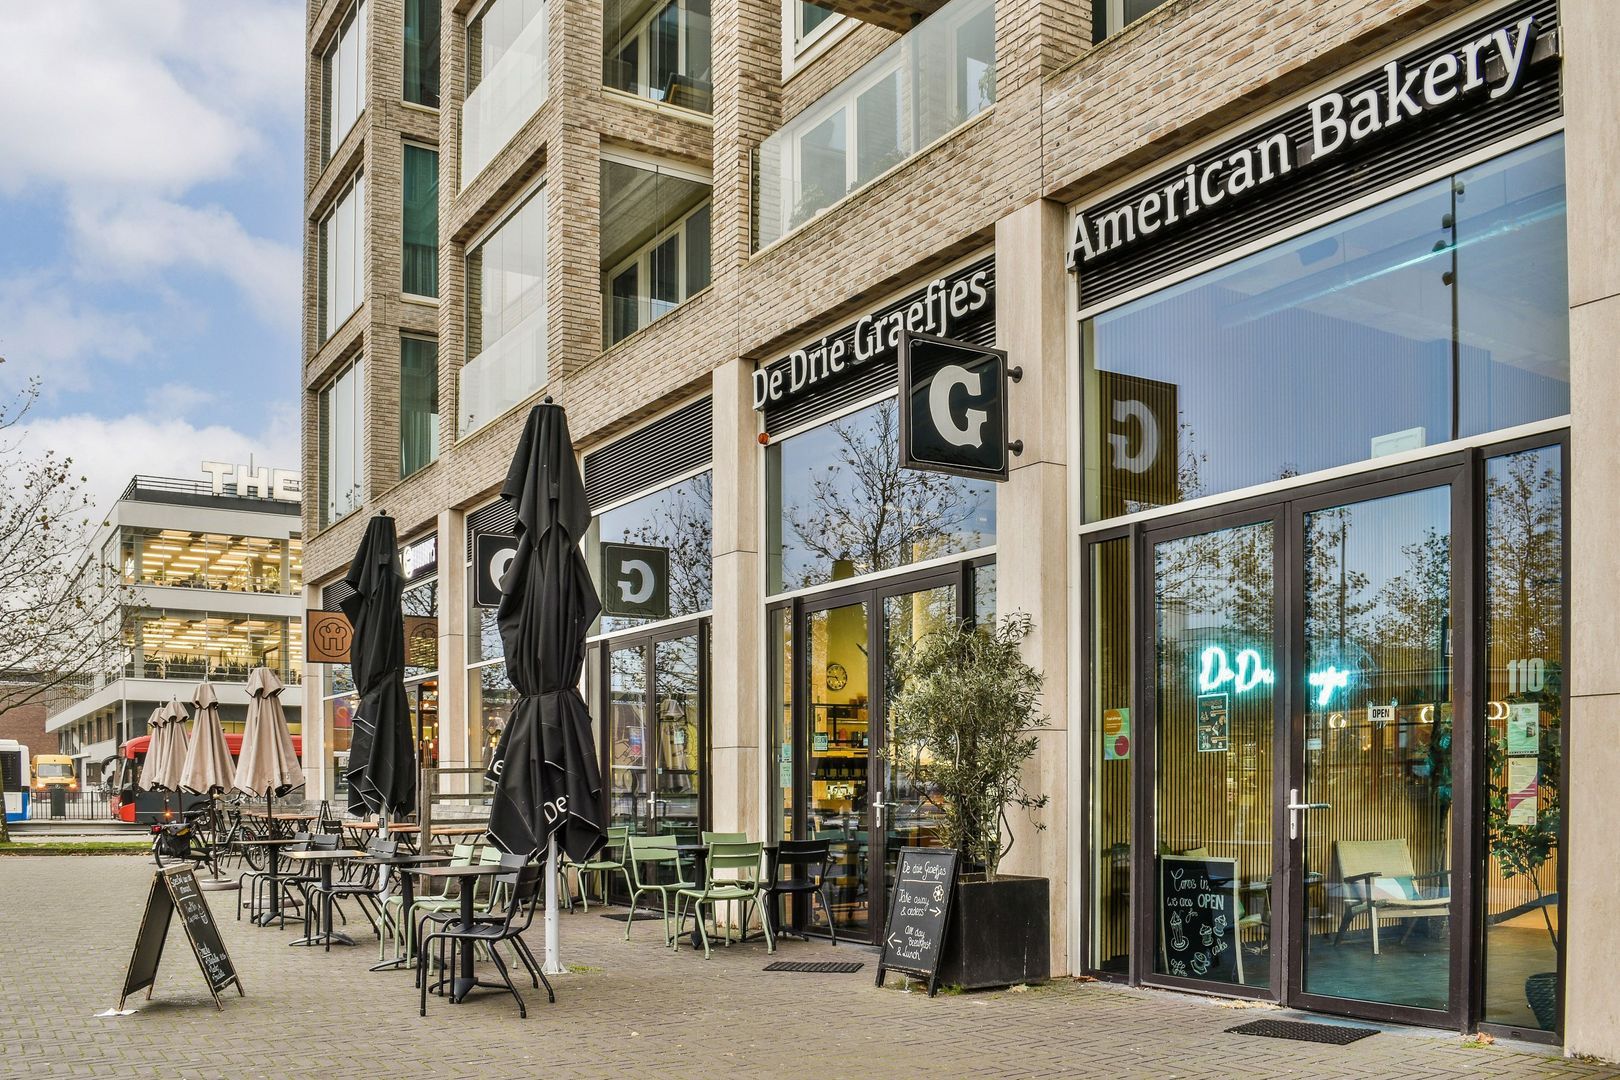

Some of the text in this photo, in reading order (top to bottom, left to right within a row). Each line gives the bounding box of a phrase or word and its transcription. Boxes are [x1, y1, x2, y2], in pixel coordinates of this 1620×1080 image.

[1065, 15, 1538, 270] American Bakery
[752, 271, 987, 411] De Drie Graefjes
[929, 364, 988, 449] G
[202, 461, 302, 501] THE
[1506, 657, 1545, 693] 110
[1372, 708, 1390, 719] OPEN
[902, 860, 911, 874] De
[1197, 893, 1225, 911] OPEN
